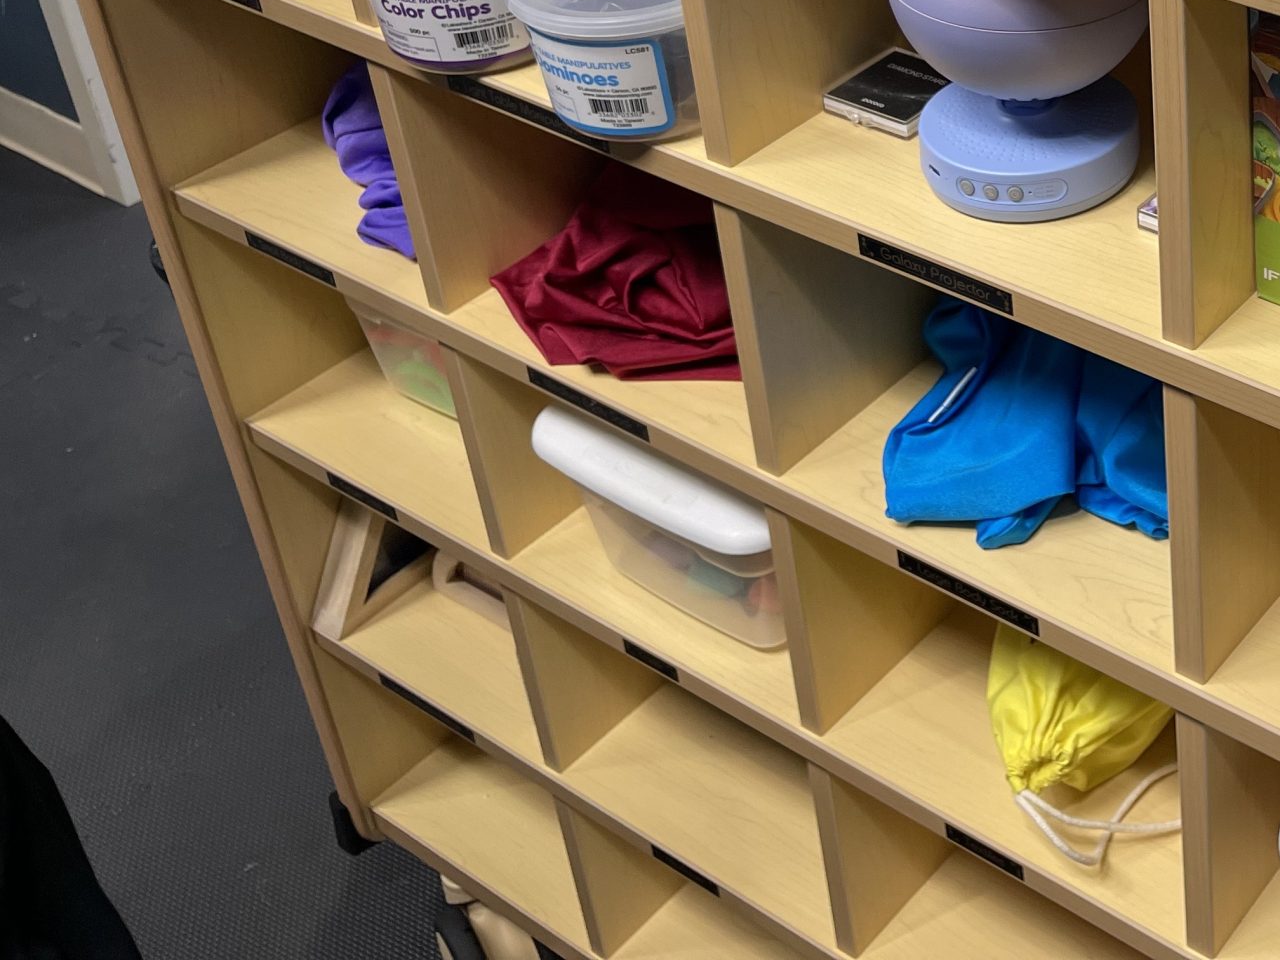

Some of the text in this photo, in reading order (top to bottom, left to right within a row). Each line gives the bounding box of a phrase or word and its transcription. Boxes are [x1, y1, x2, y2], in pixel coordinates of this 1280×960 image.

[431, 1, 492, 21] Chips
[625, 46, 650, 55] LC581
[557, 56, 632, 70] MANIPULATIVES
[879, 246, 992, 301] Galaxy Projector
